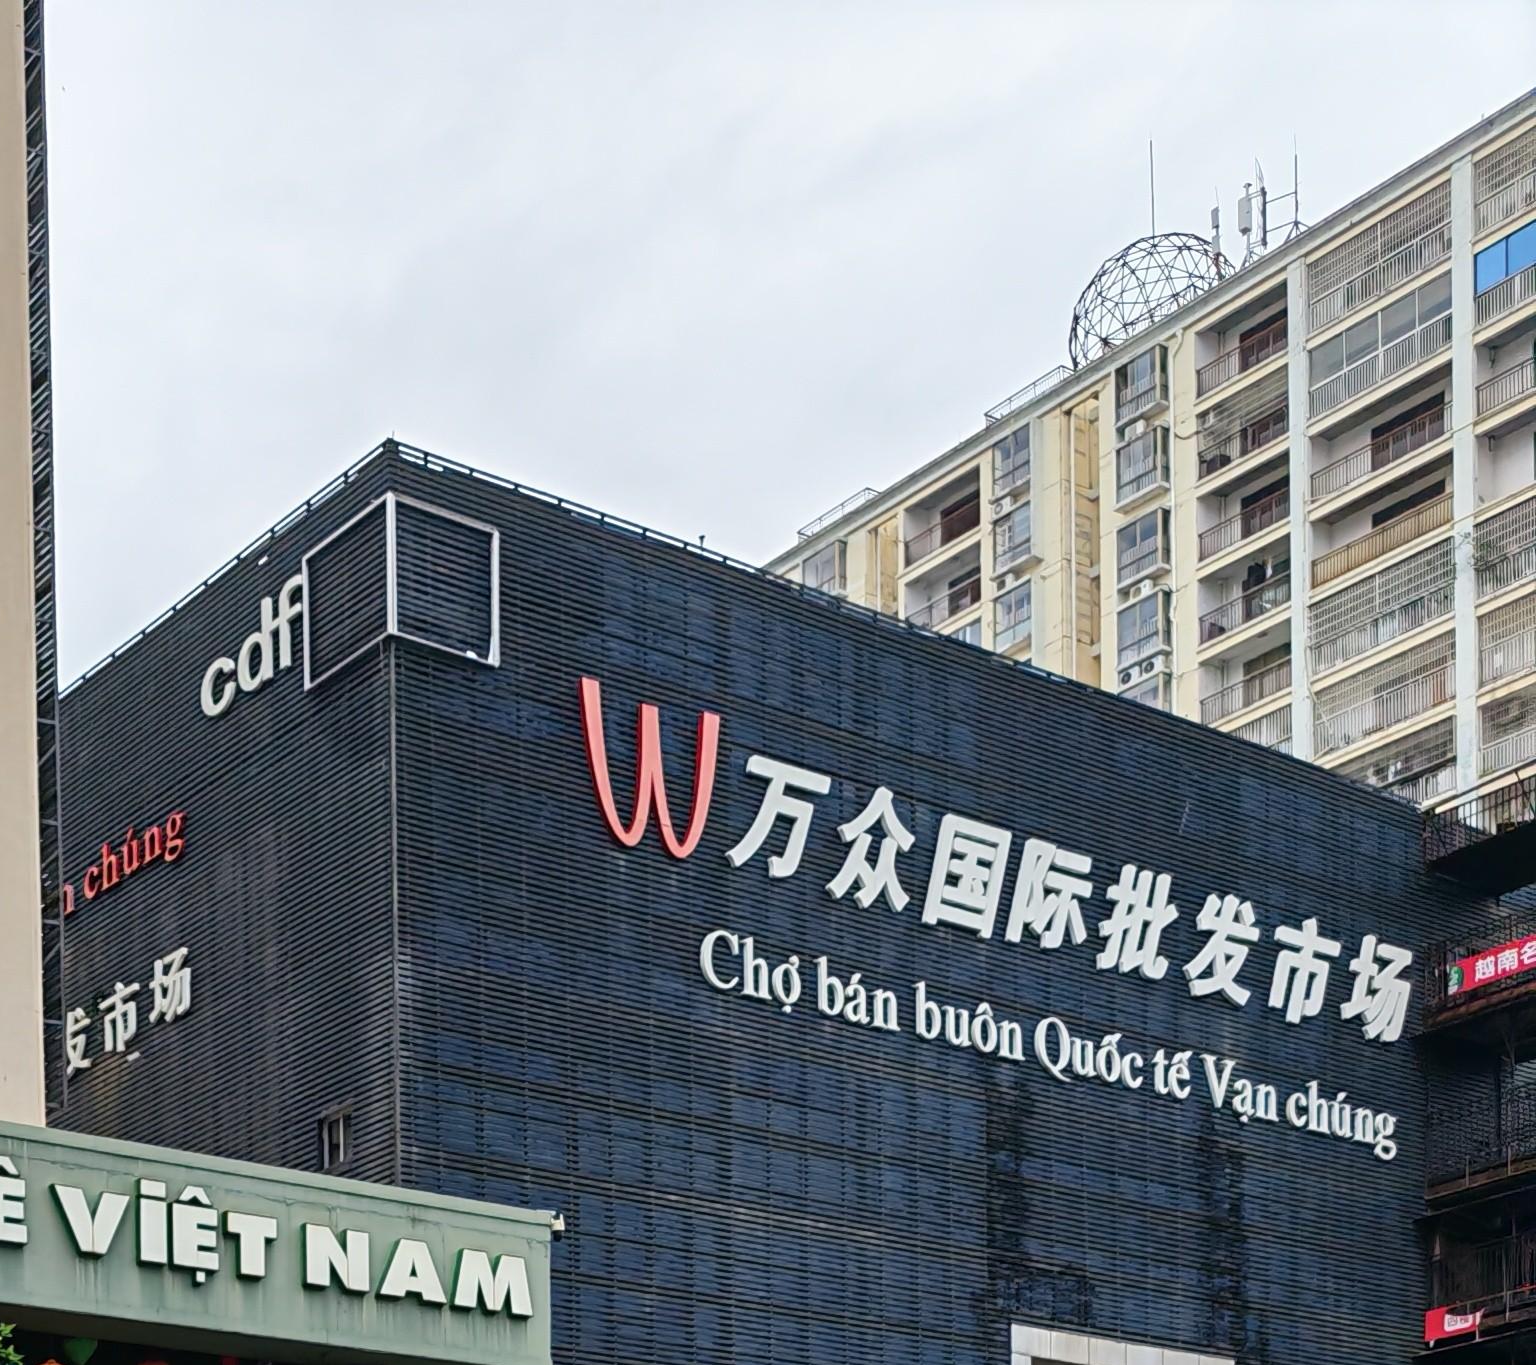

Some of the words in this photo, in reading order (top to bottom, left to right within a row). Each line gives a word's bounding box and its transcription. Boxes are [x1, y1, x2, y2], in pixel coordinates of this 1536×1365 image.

[200, 573, 304, 717] cdf
[725, 754, 1415, 1044] 万众国际批发市场
[699, 929, 802, 1014] Chợ
[813, 955, 901, 1032] bán
[913, 981, 1025, 1062] buôn
[1034, 1016, 1144, 1090] Quốc
[1199, 1053, 1279, 1124] Vạn
[1287, 1081, 1397, 1161] chúng
[302, 1222, 534, 1319] NAM
